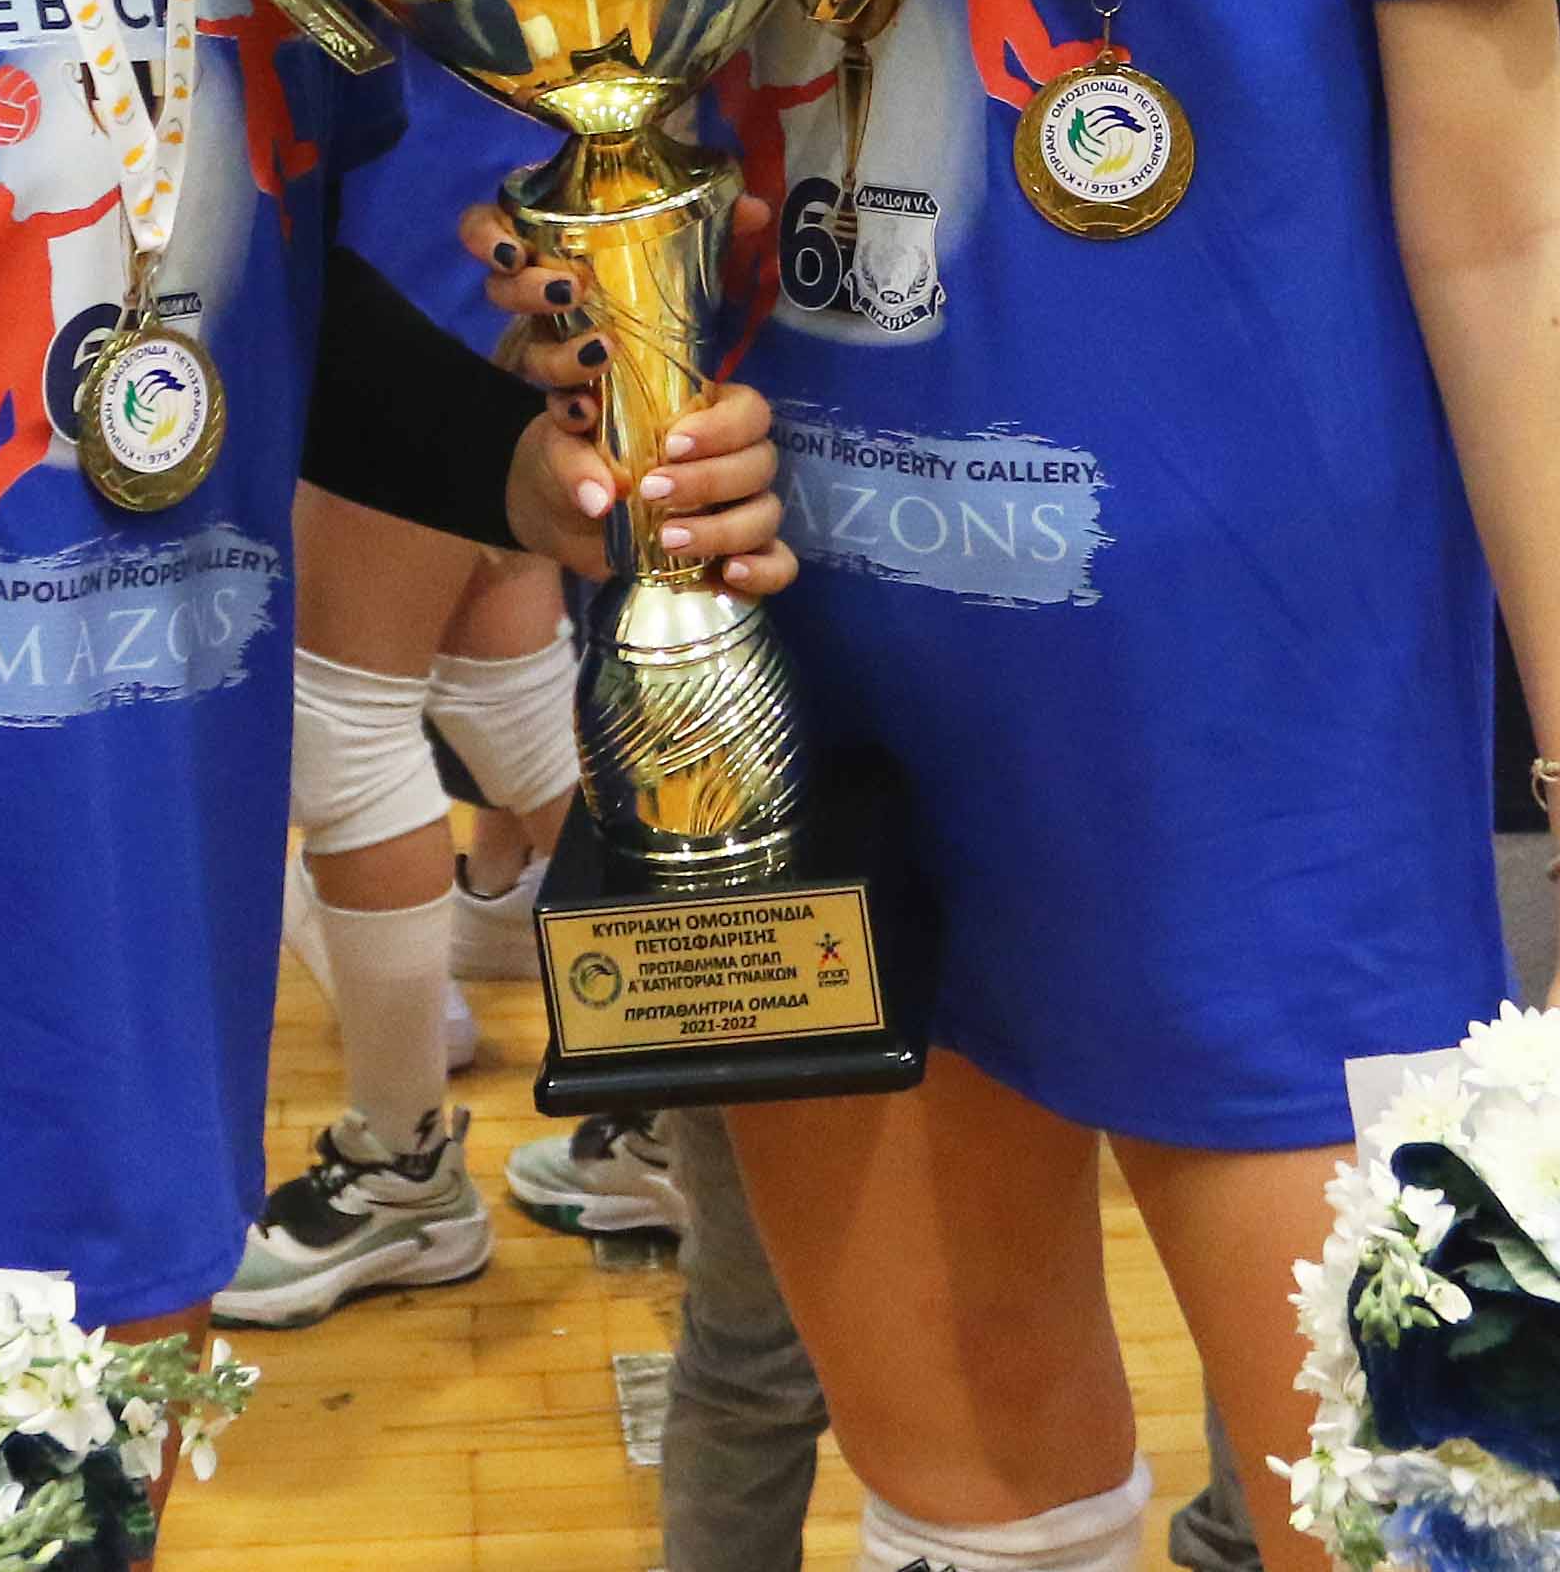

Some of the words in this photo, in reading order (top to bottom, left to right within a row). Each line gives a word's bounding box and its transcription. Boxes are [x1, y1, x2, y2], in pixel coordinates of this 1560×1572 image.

[1051, 81, 1129, 119] ΟΜΟΣΠΟΝΔΙΑ
[1044, 124, 1076, 184] ΚΥΠΡΙΑΚΗ
[1132, 92, 1164, 188] ΠΕΤΟΣΦΑΙΡΙΣΗΣ
[1083, 183, 1119, 196] 1978
[830, 439, 958, 481] PROPERTY
[965, 459, 1099, 484] GALLERY
[591, 916, 681, 938] ΚΥΠΡΙΑΚΗ
[686, 905, 815, 929] ΟΜΟΣΠΟΝΔΙΑ
[635, 929, 777, 955] ΠΕΤΟΣΦΑΙΡΙΣΗΣ
[638, 956, 738, 976] ΠΡΩΤΑΘΛΗΜΑ
[741, 951, 782, 968] ΟΠΑΠ
[728, 967, 797, 986] ΓΥΝΑΙΚΩΝ
[624, 998, 744, 1022] ΠΡΩΤΑΘΛΗΤΡΙΑ
[749, 993, 809, 1011] ΟΜΑΔΑ
[680, 1016, 757, 1035] 2021-2022
